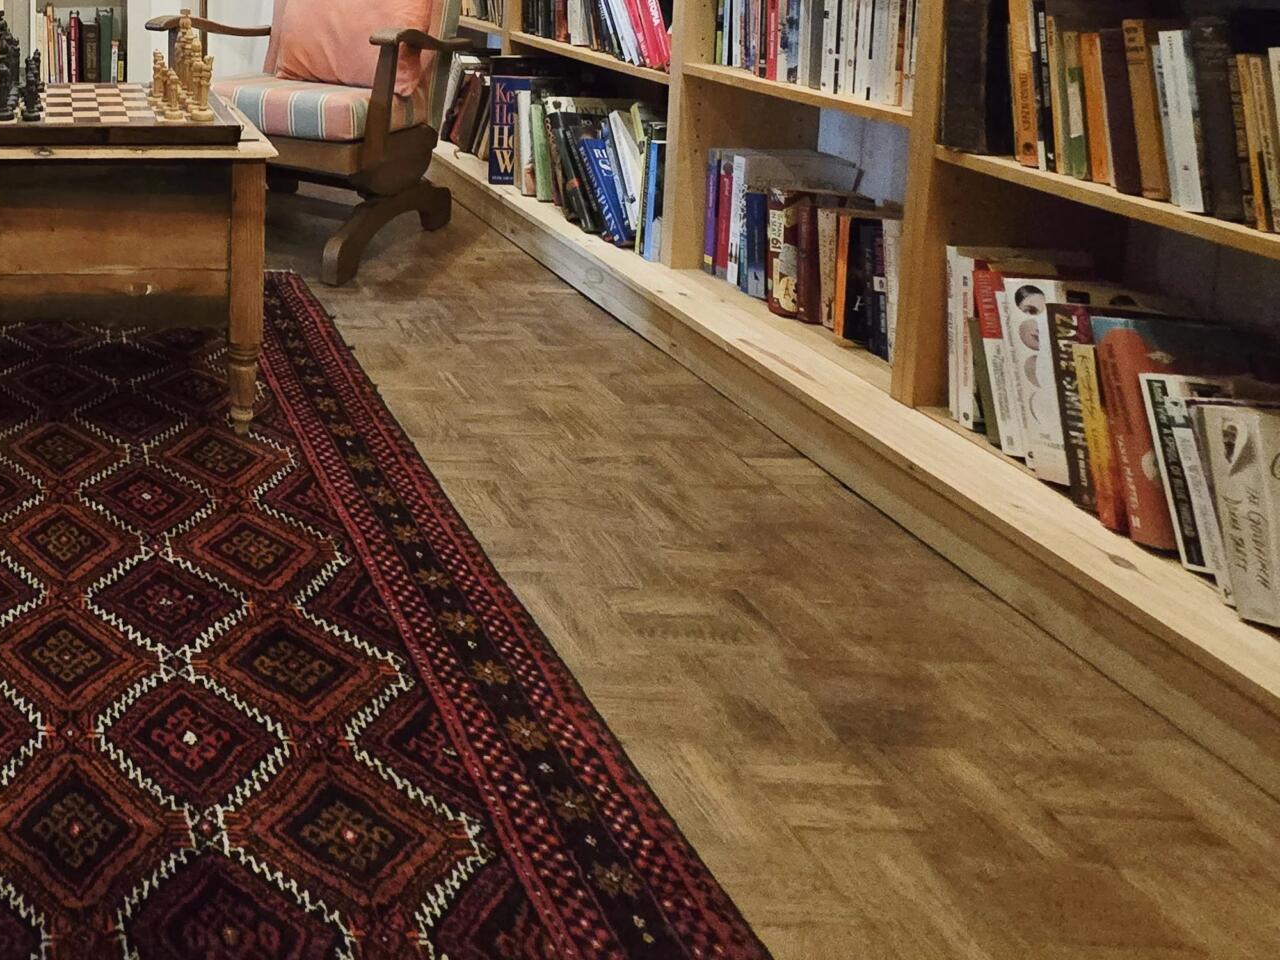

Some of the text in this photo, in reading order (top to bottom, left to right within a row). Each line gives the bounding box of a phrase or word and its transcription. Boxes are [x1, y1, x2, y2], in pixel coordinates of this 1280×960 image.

[596, 187, 617, 231] SPAIN
[771, 236, 782, 251] 61
[1062, 376, 1086, 446] SMITH
